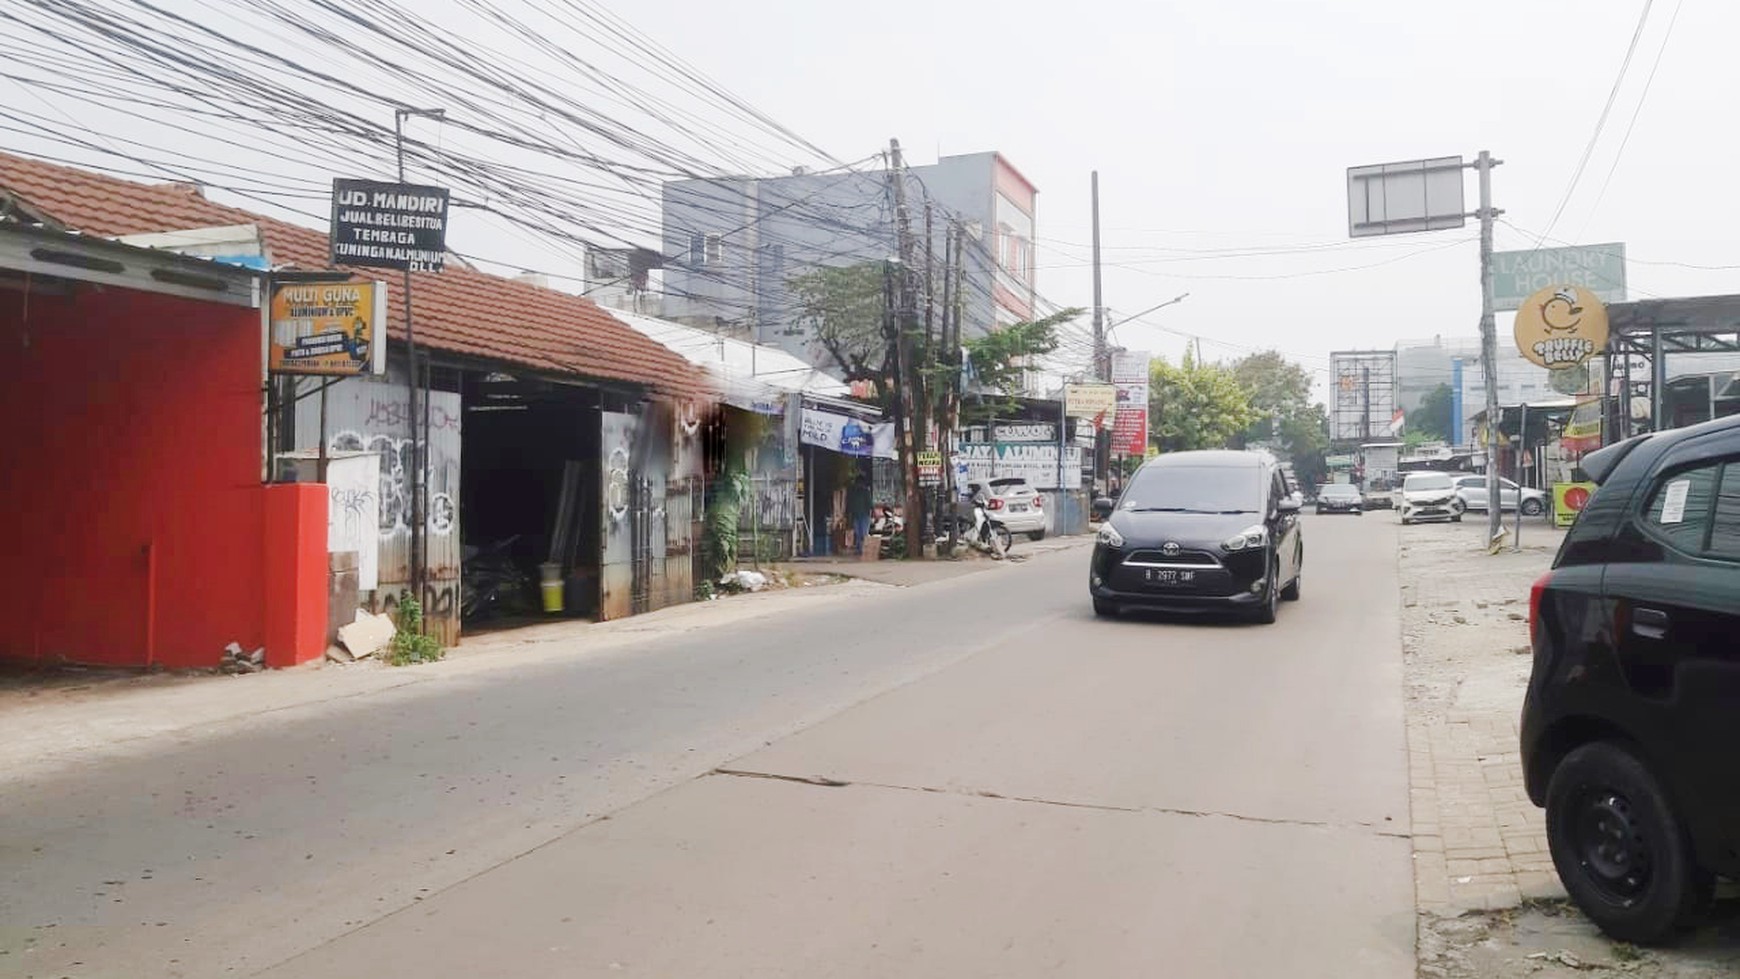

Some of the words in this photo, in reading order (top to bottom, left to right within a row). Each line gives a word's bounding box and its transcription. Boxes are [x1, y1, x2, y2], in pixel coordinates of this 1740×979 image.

[353, 228, 415, 245] TEMBAGA
[1500, 248, 1609, 274] LAUNDRY
[1515, 271, 1597, 293] HOUSE
[324, 287, 360, 302] GUNA
[1533, 338, 1594, 357] TRUFFLE
[1544, 349, 1584, 365] BELLY
